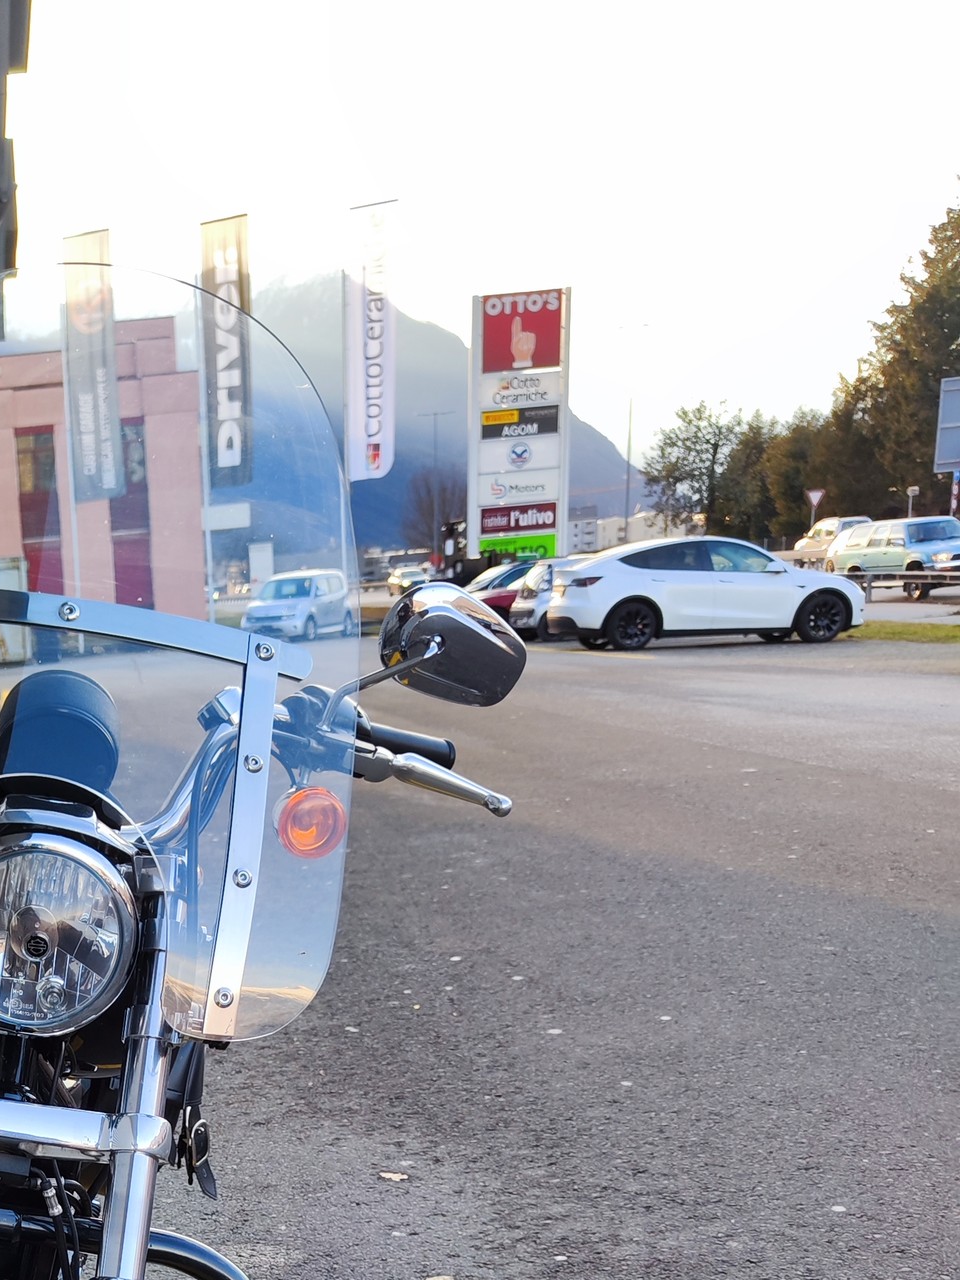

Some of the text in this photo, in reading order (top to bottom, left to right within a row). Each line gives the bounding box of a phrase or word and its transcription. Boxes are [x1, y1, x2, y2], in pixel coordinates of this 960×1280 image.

[484, 291, 560, 316] OTTO'S
[510, 376, 541, 390] Cotto
[492, 390, 549, 405] Ceramiche
[501, 422, 539, 437] AGOM
[509, 484, 546, 494] Motors
